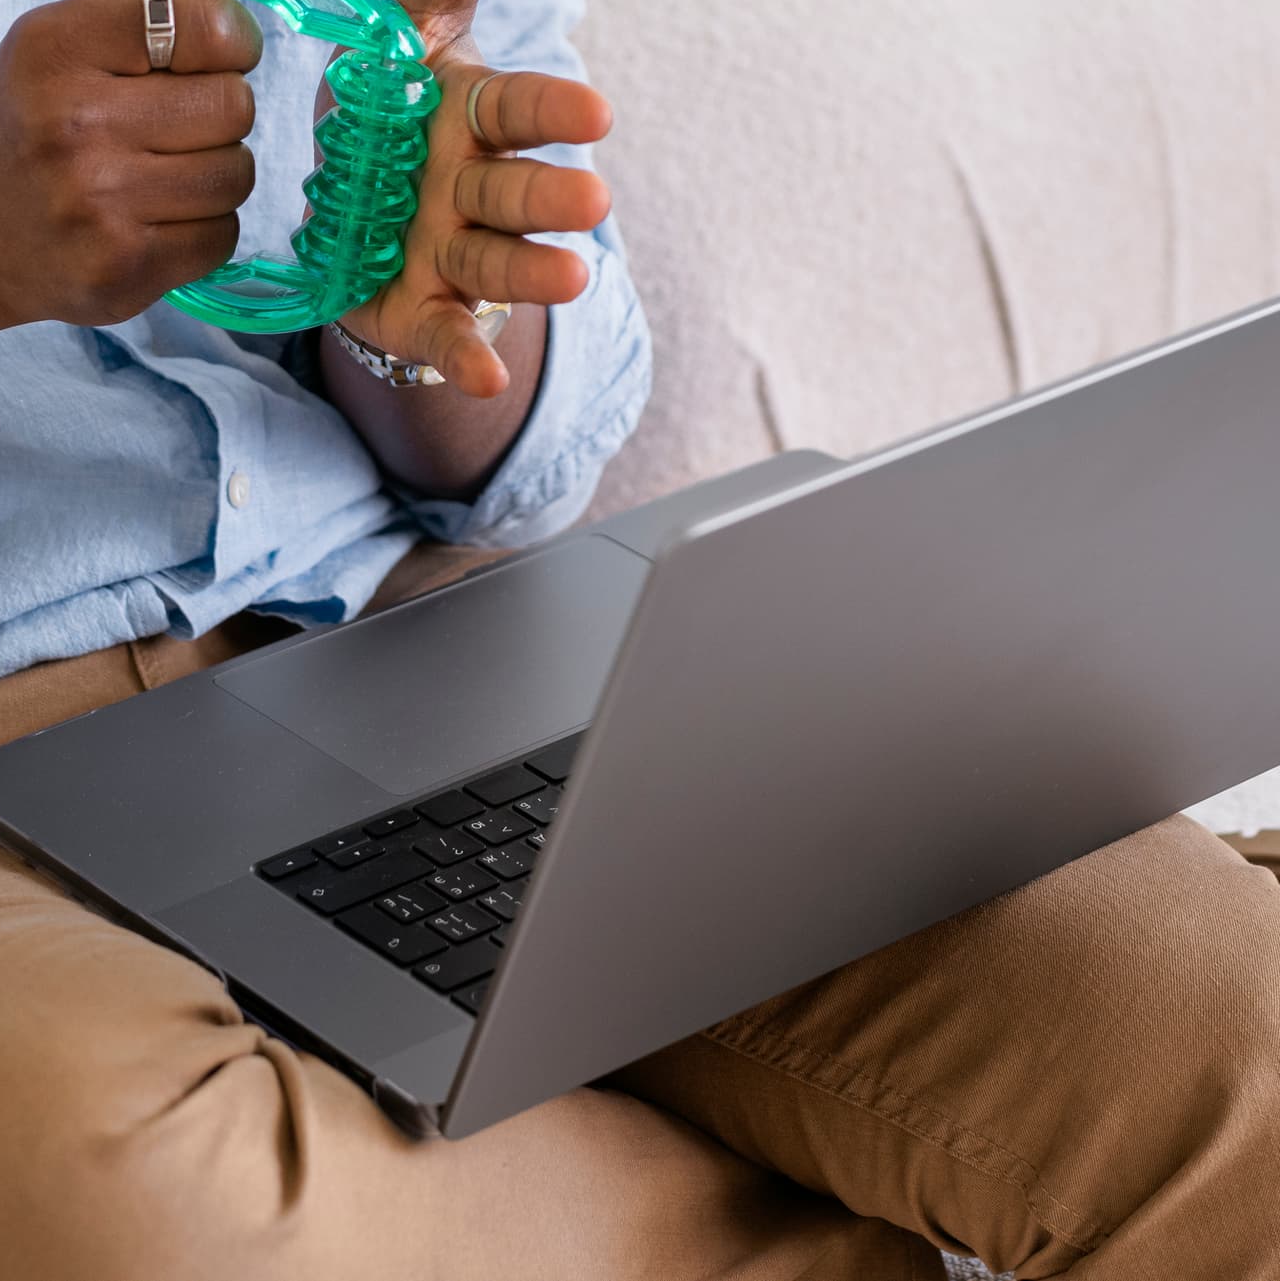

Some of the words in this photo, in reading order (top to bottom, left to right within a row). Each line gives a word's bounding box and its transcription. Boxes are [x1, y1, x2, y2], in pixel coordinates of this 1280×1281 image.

[471, 821, 486, 830] Ю
[452, 847, 464, 856] ?
[481, 854, 498, 864] Ж
